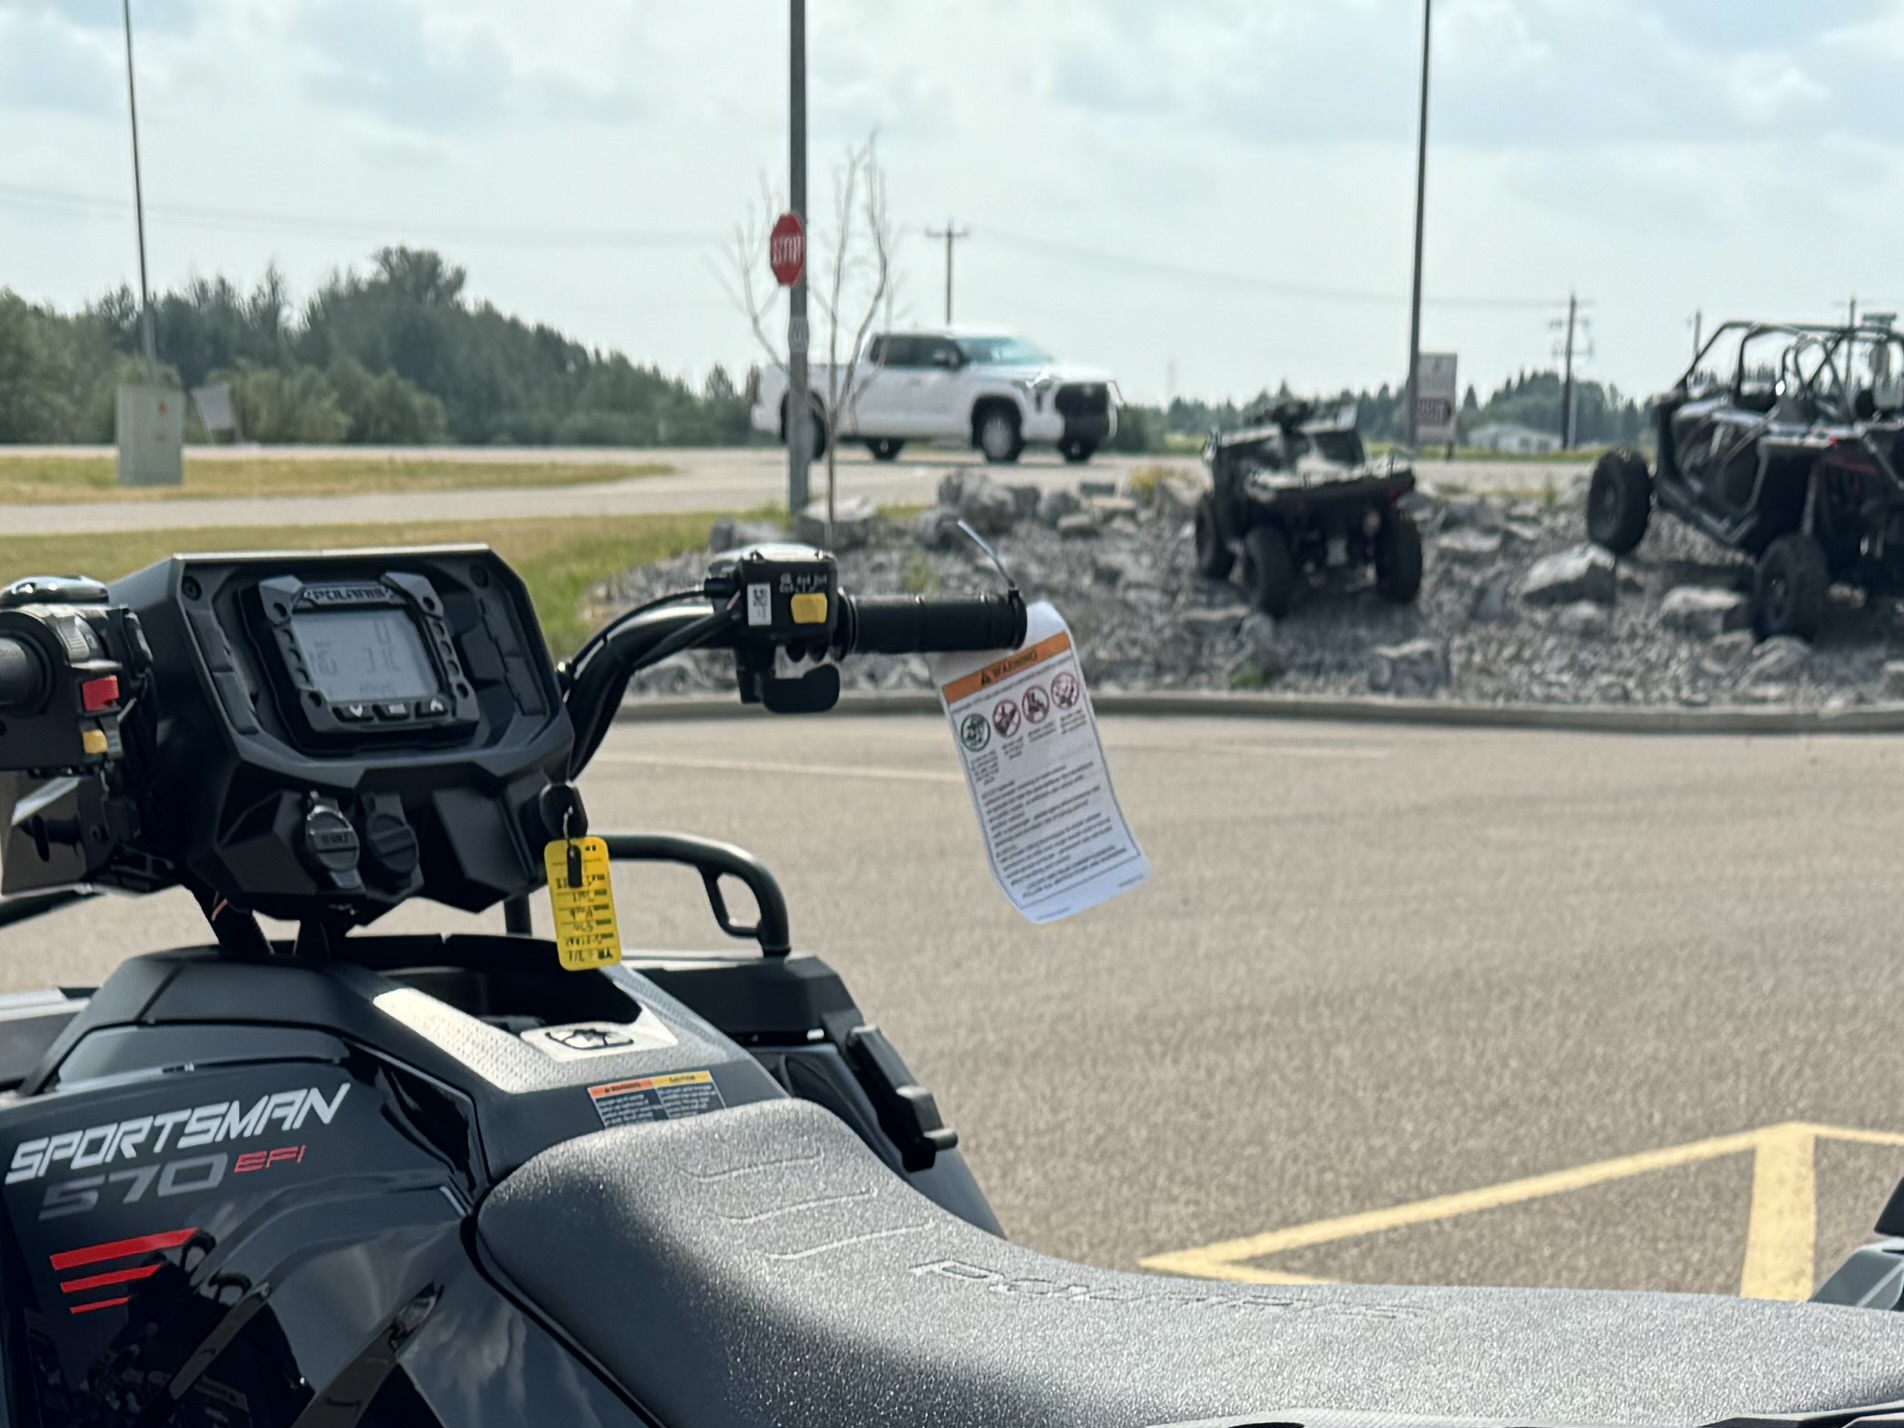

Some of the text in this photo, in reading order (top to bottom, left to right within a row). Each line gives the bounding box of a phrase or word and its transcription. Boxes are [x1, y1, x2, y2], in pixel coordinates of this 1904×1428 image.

[5, 1083, 350, 1184] SPORTSMAN
[39, 1145, 306, 1220] 570 EFI
